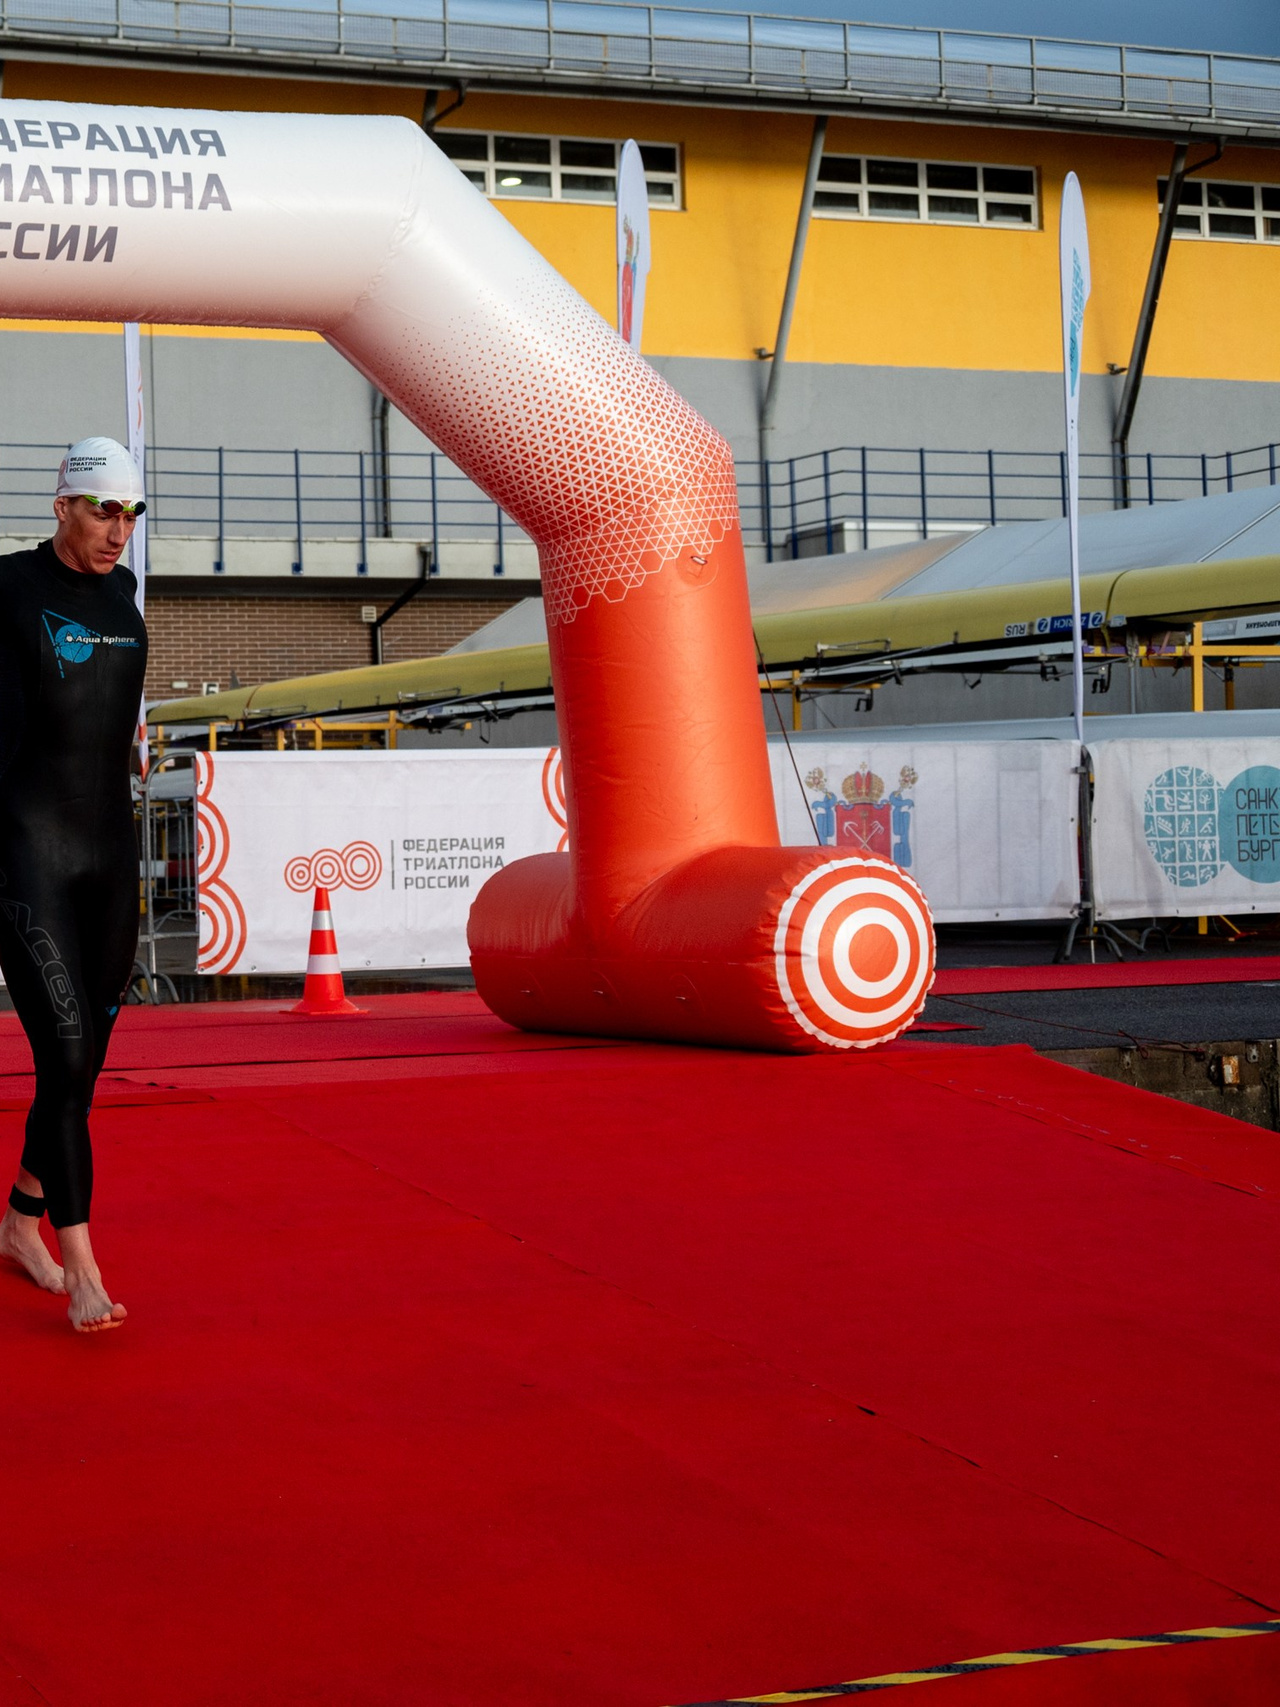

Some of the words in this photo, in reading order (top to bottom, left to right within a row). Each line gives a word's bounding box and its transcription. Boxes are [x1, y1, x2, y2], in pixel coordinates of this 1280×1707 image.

[1005, 624, 1026, 637] RUS
[76, 635, 101, 645] Aqua
[402, 836, 505, 854] ФЕДЕРАЦИЯ
[403, 855, 505, 871] ТРИАТЛОНА
[404, 875, 470, 890] РОССИИ
